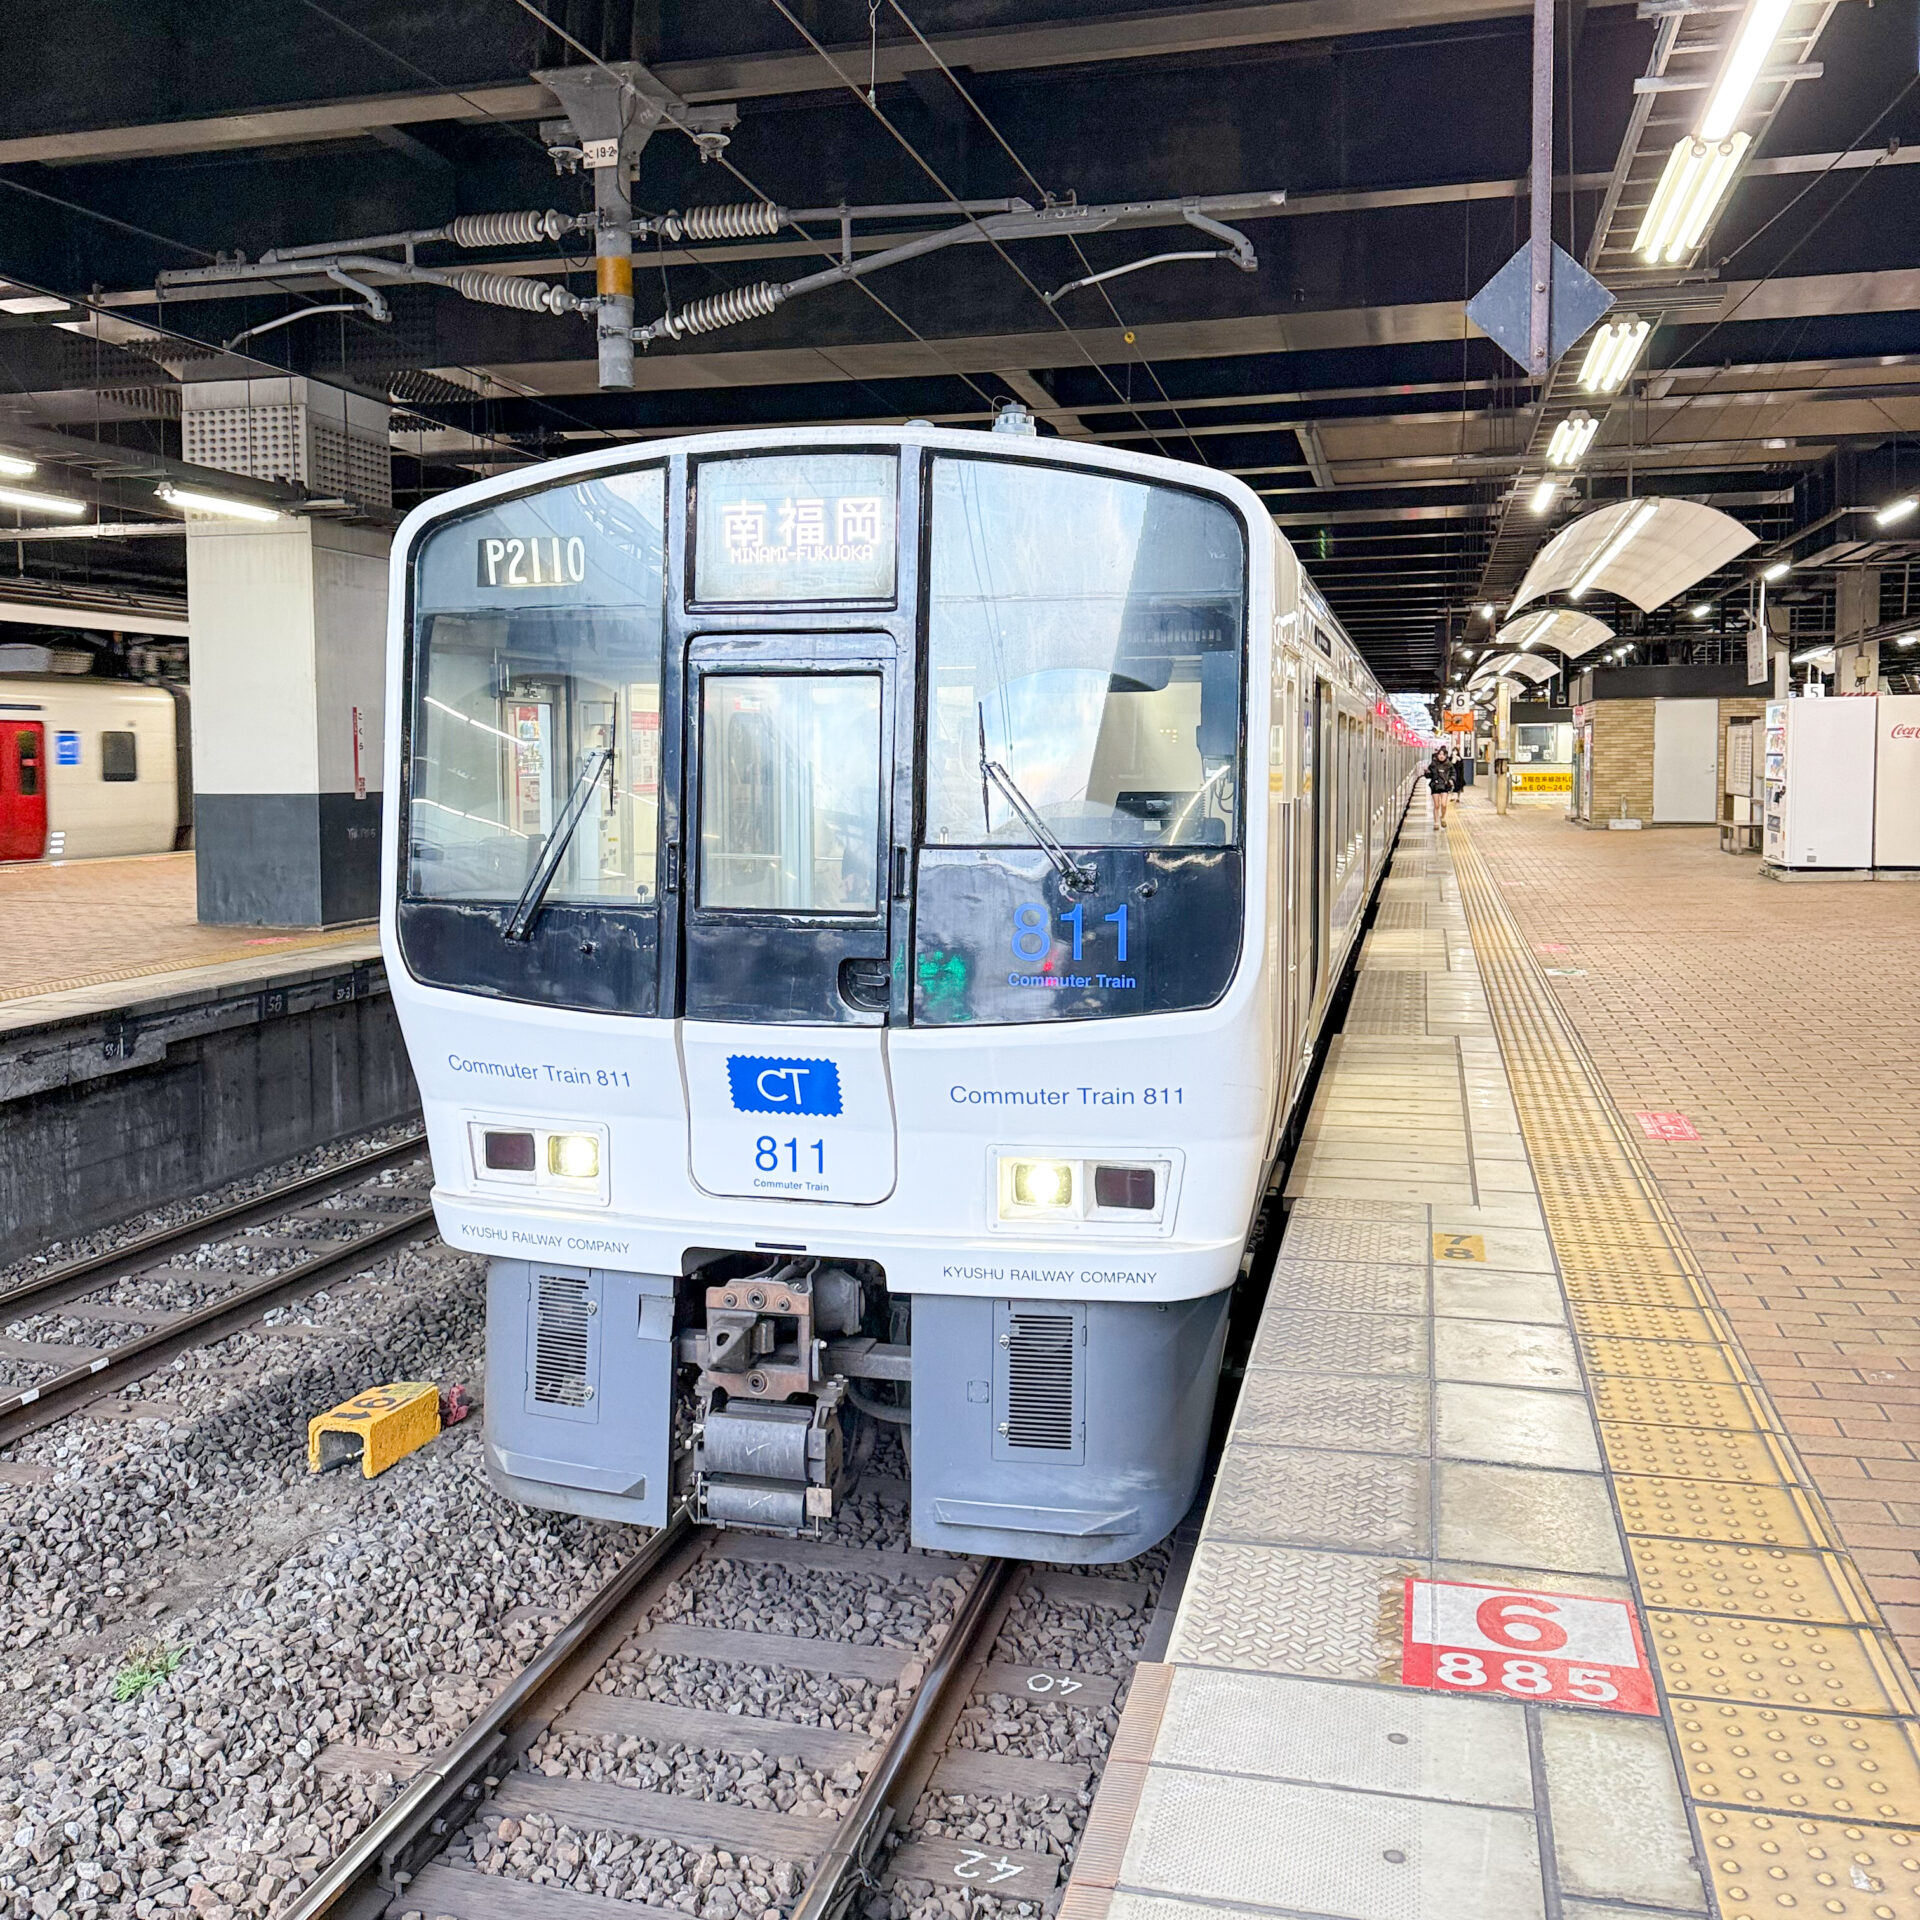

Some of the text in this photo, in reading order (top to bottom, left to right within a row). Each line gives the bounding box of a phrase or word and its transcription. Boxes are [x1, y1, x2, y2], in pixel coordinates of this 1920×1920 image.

[721, 497, 882, 548] 南福岡
[485, 536, 585, 586] P2110
[731, 545, 874, 564] MINAMI-FUKUOKA
[1456, 694, 1465, 707] 6
[1011, 902, 1128, 962] 811
[1008, 972, 1136, 989] Commuter Train
[448, 1054, 630, 1088] Commuter Train 811
[756, 1067, 811, 1105] CT
[949, 1085, 1184, 1105] Commuter Train 811
[755, 1135, 824, 1174] 811
[753, 1178, 830, 1192] Commuter Train
[461, 1223, 630, 1254] KYUSHU RAILWAY COMPANY
[1443, 1233, 1473, 1246] 7
[1443, 1247, 1476, 1260] 8
[943, 1265, 1158, 1285] KYUSHU RAILWAY COMPANY
[1475, 1595, 1568, 1652] 6
[1436, 1651, 1619, 1702] 885
